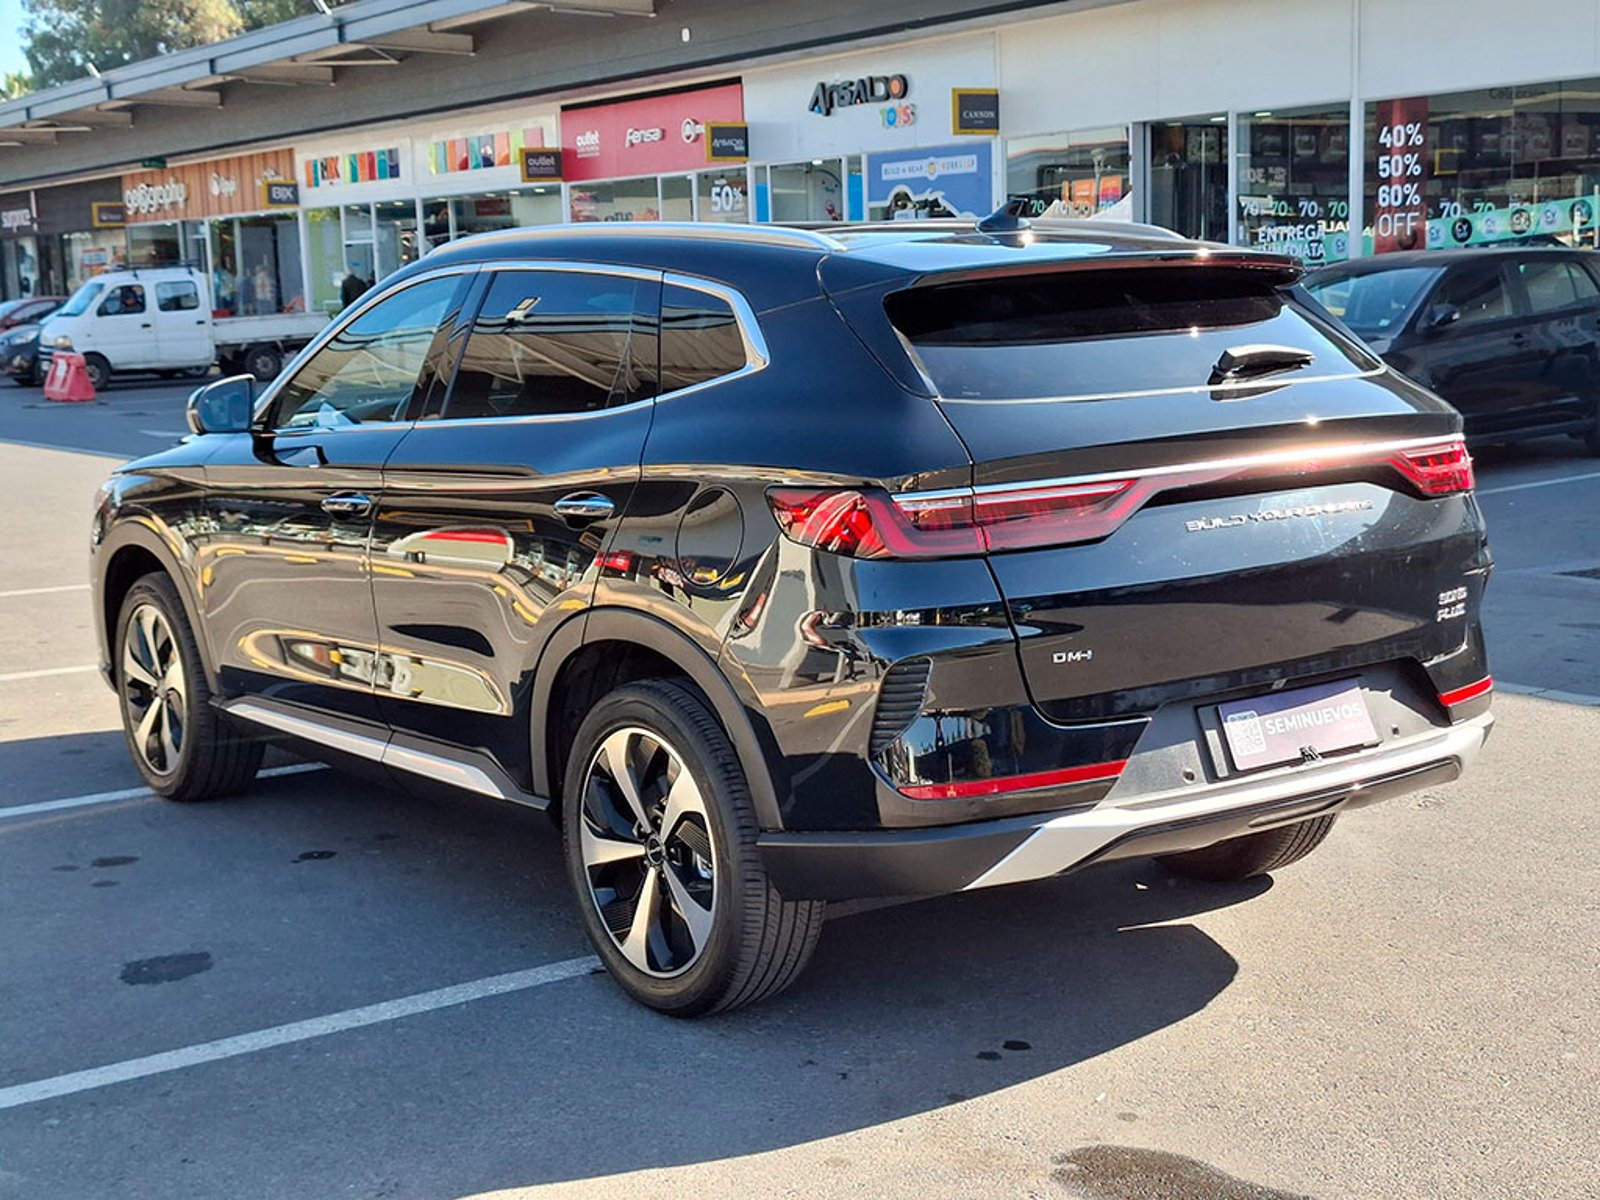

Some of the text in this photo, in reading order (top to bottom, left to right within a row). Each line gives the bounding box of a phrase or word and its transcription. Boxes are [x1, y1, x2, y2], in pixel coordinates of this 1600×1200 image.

[1379, 122, 1424, 148] 40%
[527, 156, 556, 167] outlet
[1379, 153, 1421, 178] 50%
[711, 186, 743, 212] 50%
[1378, 183, 1421, 207] 60%
[1258, 223, 1326, 243] ENTREGA
[1379, 211, 1420, 237] OFF
[1185, 514, 1246, 532] BUILD
[1265, 702, 1363, 736] SEMINUEVOS
